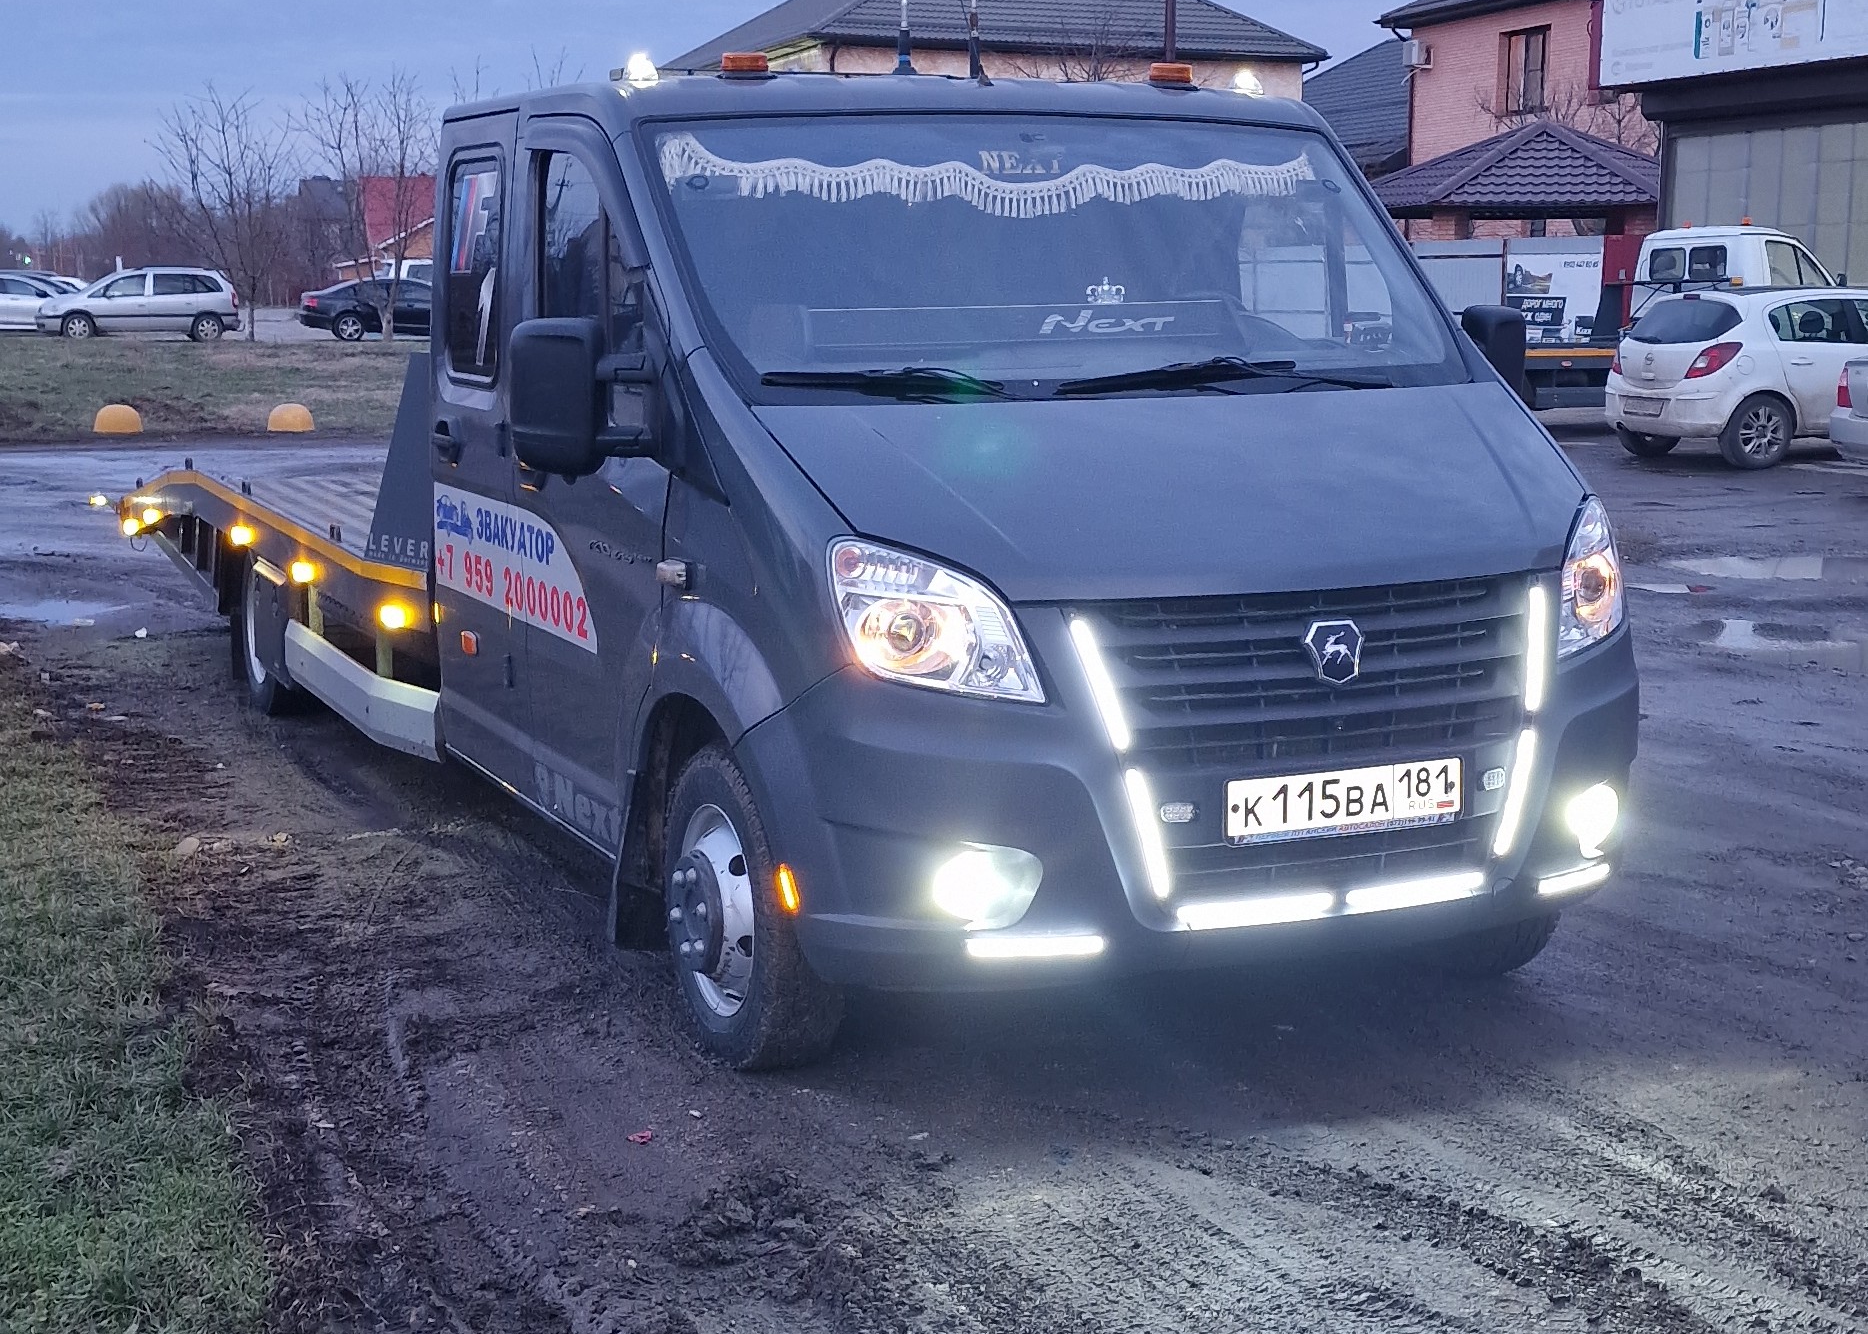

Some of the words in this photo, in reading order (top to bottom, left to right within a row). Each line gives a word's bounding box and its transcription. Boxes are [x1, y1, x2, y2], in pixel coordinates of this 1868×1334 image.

[368, 532, 429, 559] LEVER
[475, 507, 555, 566] ЭВАКУАТОР
[436, 544, 454, 581] +7
[463, 550, 494, 598] 959
[502, 566, 589, 641] 2000002
[1398, 764, 1450, 800] 181
[1408, 799, 1435, 811] RUS
